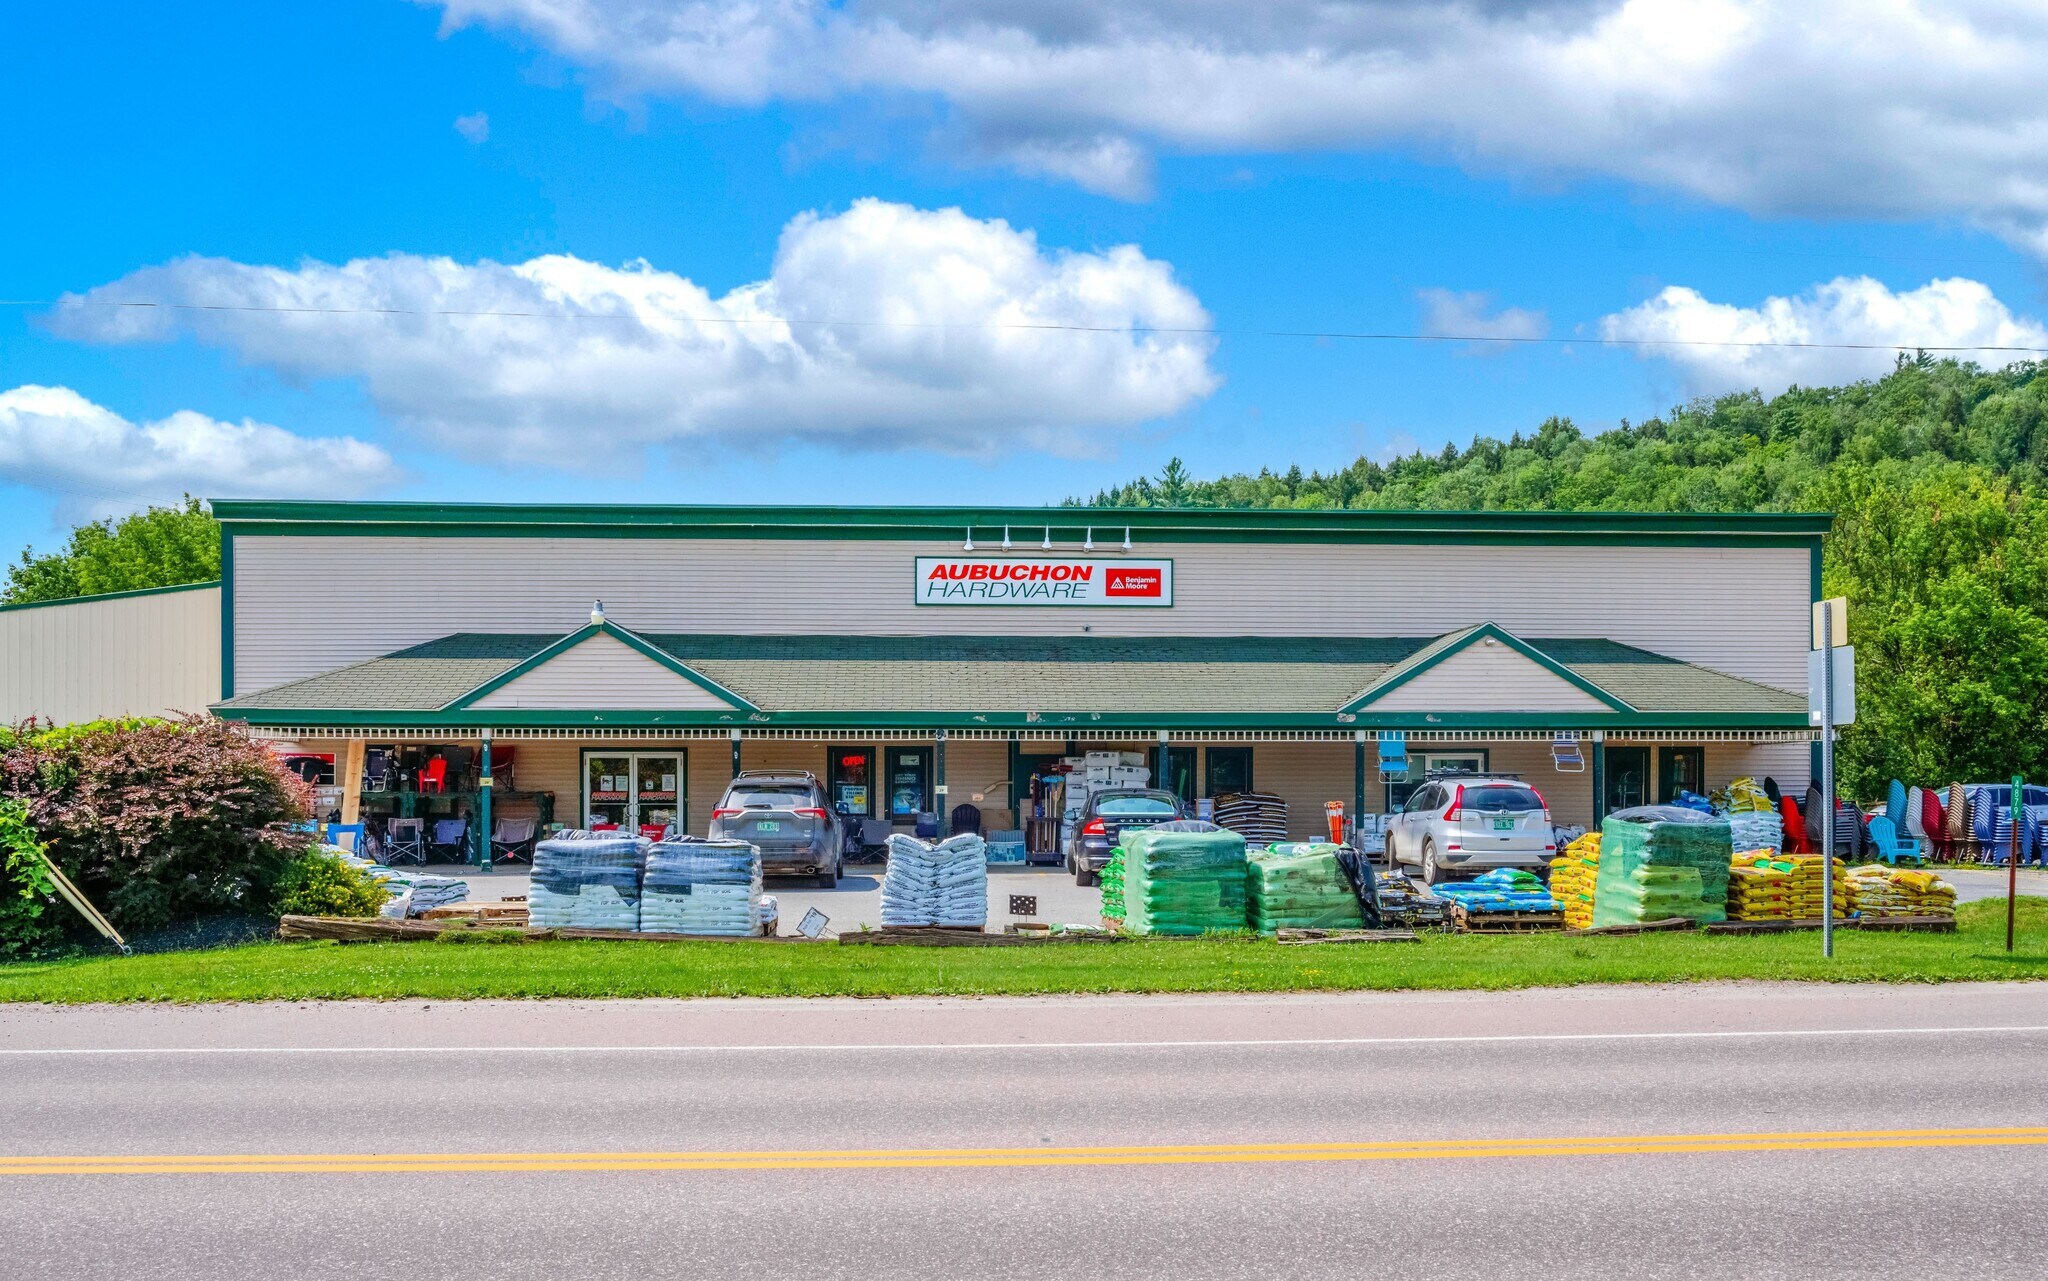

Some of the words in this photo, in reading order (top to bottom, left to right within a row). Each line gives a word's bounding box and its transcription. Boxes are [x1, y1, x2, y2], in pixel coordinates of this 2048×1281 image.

[928, 564, 1093, 581] AUBUCHON
[1125, 576, 1157, 584] Benjamin
[927, 582, 1090, 598] HARDWARE
[842, 755, 865, 766] OPEN
